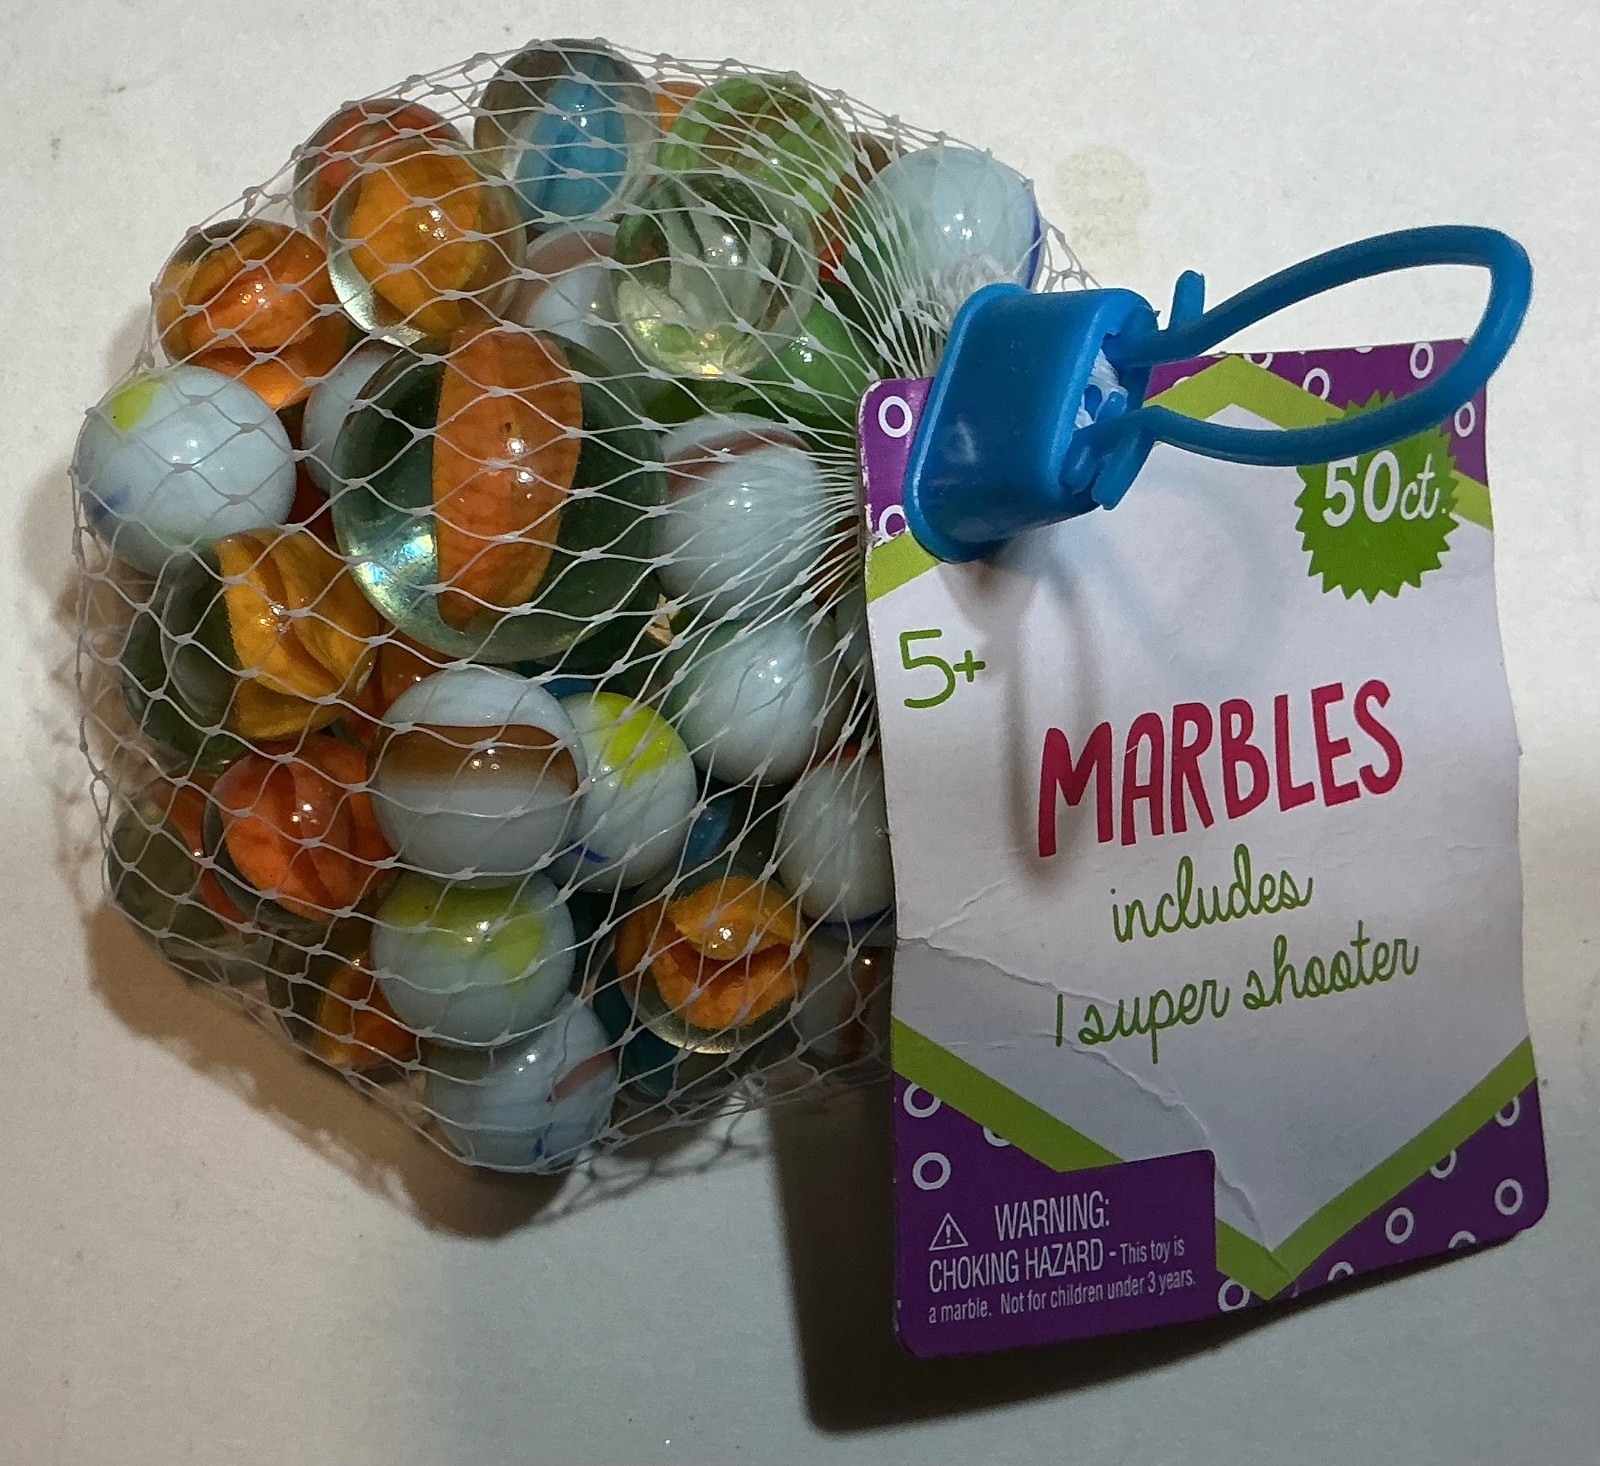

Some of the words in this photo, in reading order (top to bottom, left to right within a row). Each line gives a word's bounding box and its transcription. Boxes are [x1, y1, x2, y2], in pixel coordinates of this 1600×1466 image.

[1322, 450, 1447, 528] 50ct.
[900, 628, 985, 709] 5+
[1038, 679, 1403, 858] MARBLES
[1110, 843, 1313, 943] includes
[1055, 992, 1064, 1047] 1
[1077, 978, 1231, 1064] super
[1242, 920, 1419, 1011] shooter
[995, 1190, 1110, 1241] WARNING:
[928, 1306, 937, 1324] a
[941, 1299, 992, 1323] marble.
[1000, 1292, 1024, 1315] Not
[1027, 1290, 1047, 1312] for
[1050, 1283, 1103, 1308] children
[1107, 1276, 1144, 1300] under
[1147, 1271, 1156, 1293] 3
[1159, 1269, 1196, 1295] years.
[929, 1250, 1019, 1293] CHOKING
[1025, 1238, 1103, 1280] HAZARD
[1120, 1241, 1147, 1266] This
[1151, 1239, 1170, 1264] toy
[1173, 1235, 1185, 1257] is
